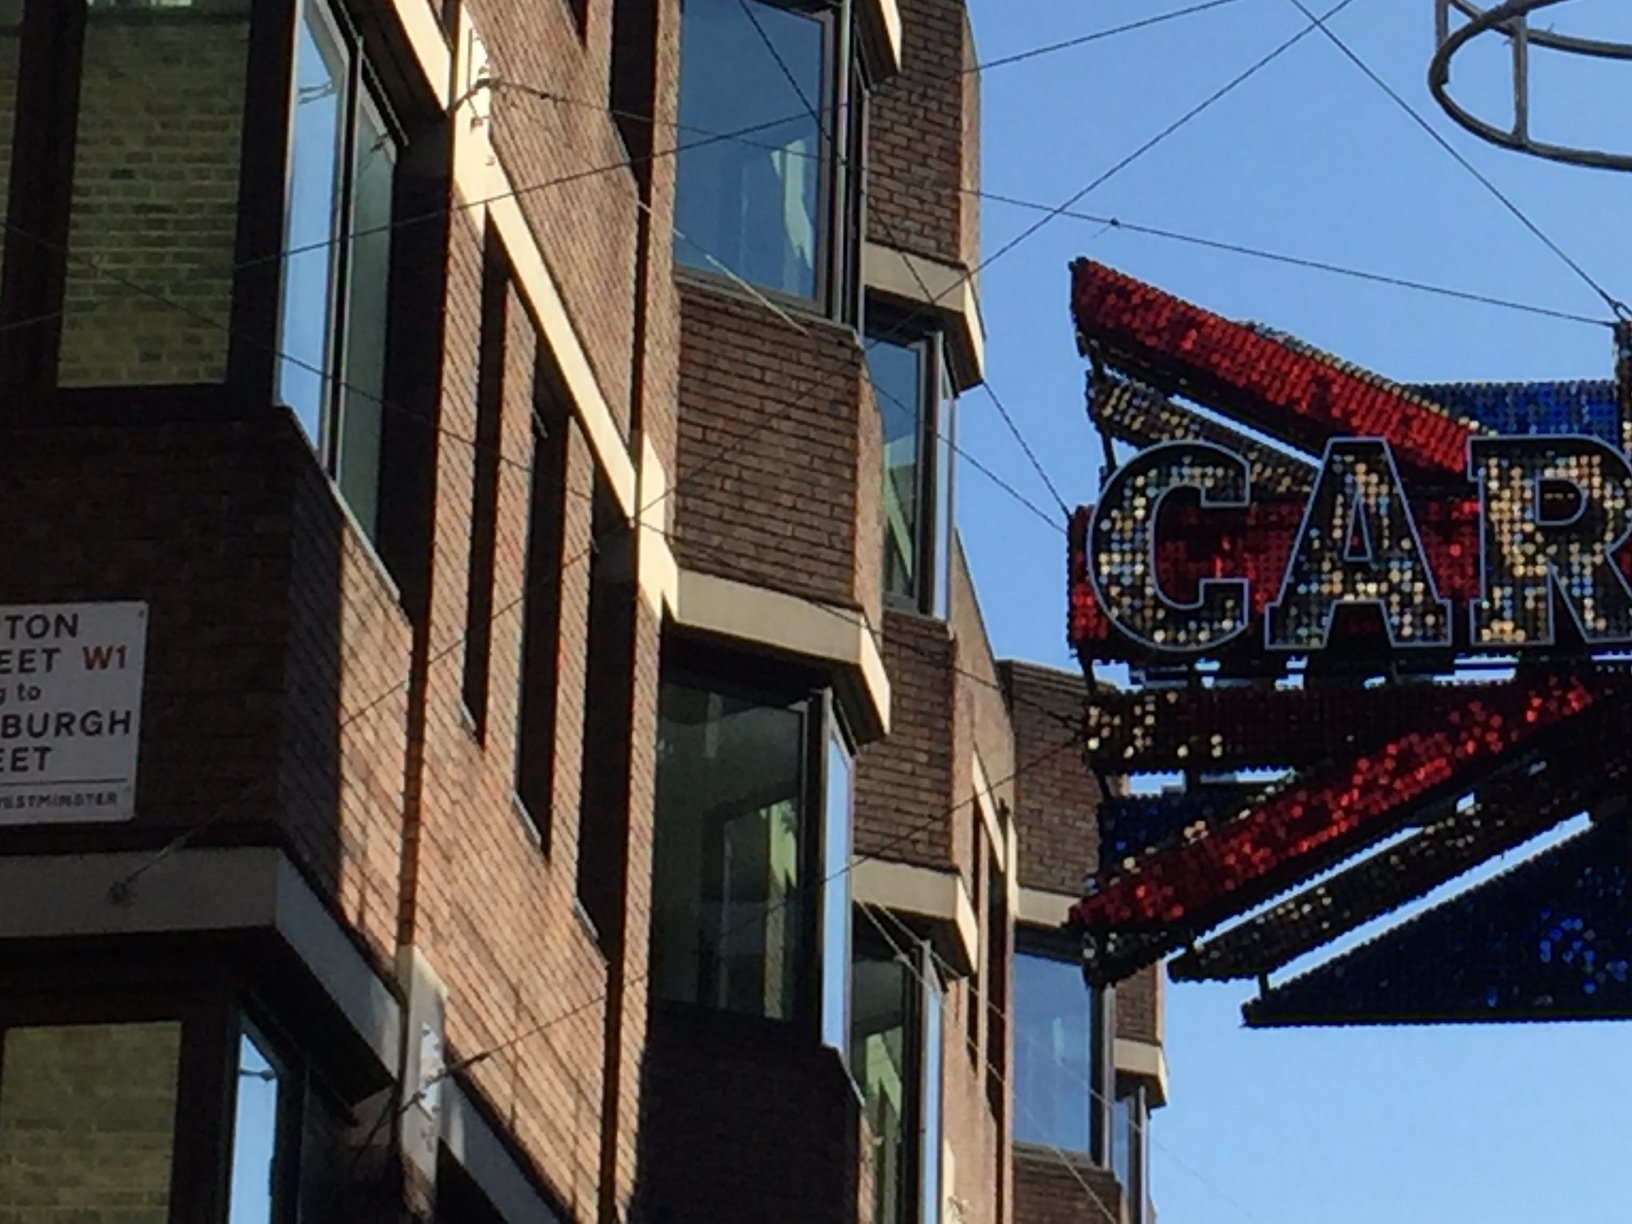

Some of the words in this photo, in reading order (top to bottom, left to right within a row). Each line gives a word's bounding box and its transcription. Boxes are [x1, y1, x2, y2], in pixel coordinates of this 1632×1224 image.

[4, 613, 79, 640] TON
[82, 645, 127, 671] W1
[17, 682, 42, 703] to
[1, 710, 132, 739] BURGH
[0, 746, 53, 773] ET
